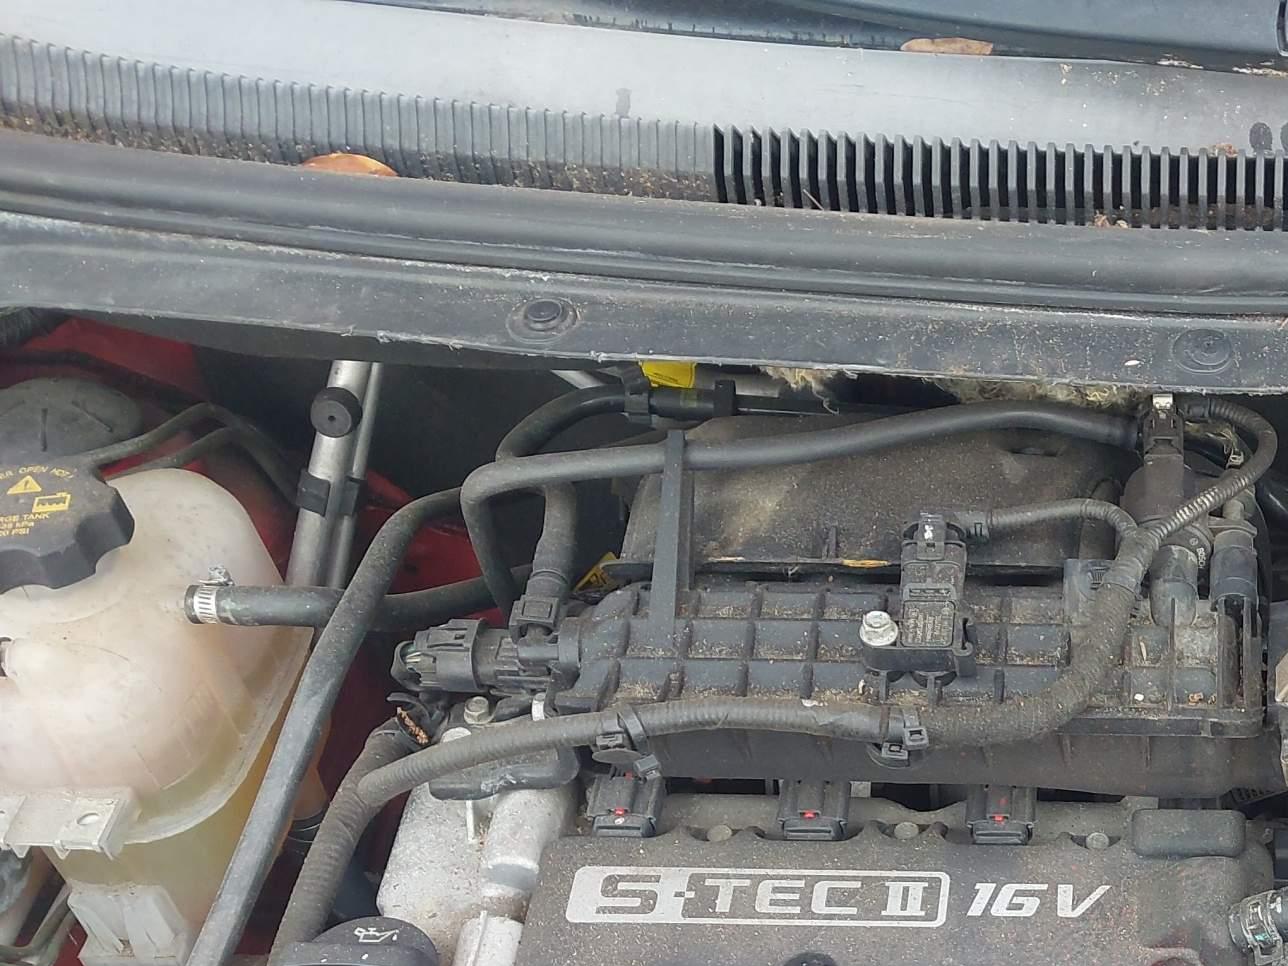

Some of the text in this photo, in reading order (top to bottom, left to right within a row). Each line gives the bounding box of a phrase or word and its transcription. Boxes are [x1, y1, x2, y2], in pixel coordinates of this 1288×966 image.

[23, 513, 49, 521] TANK
[594, 873, 862, 916] S-TEC
[966, 882, 1113, 918] 16V
